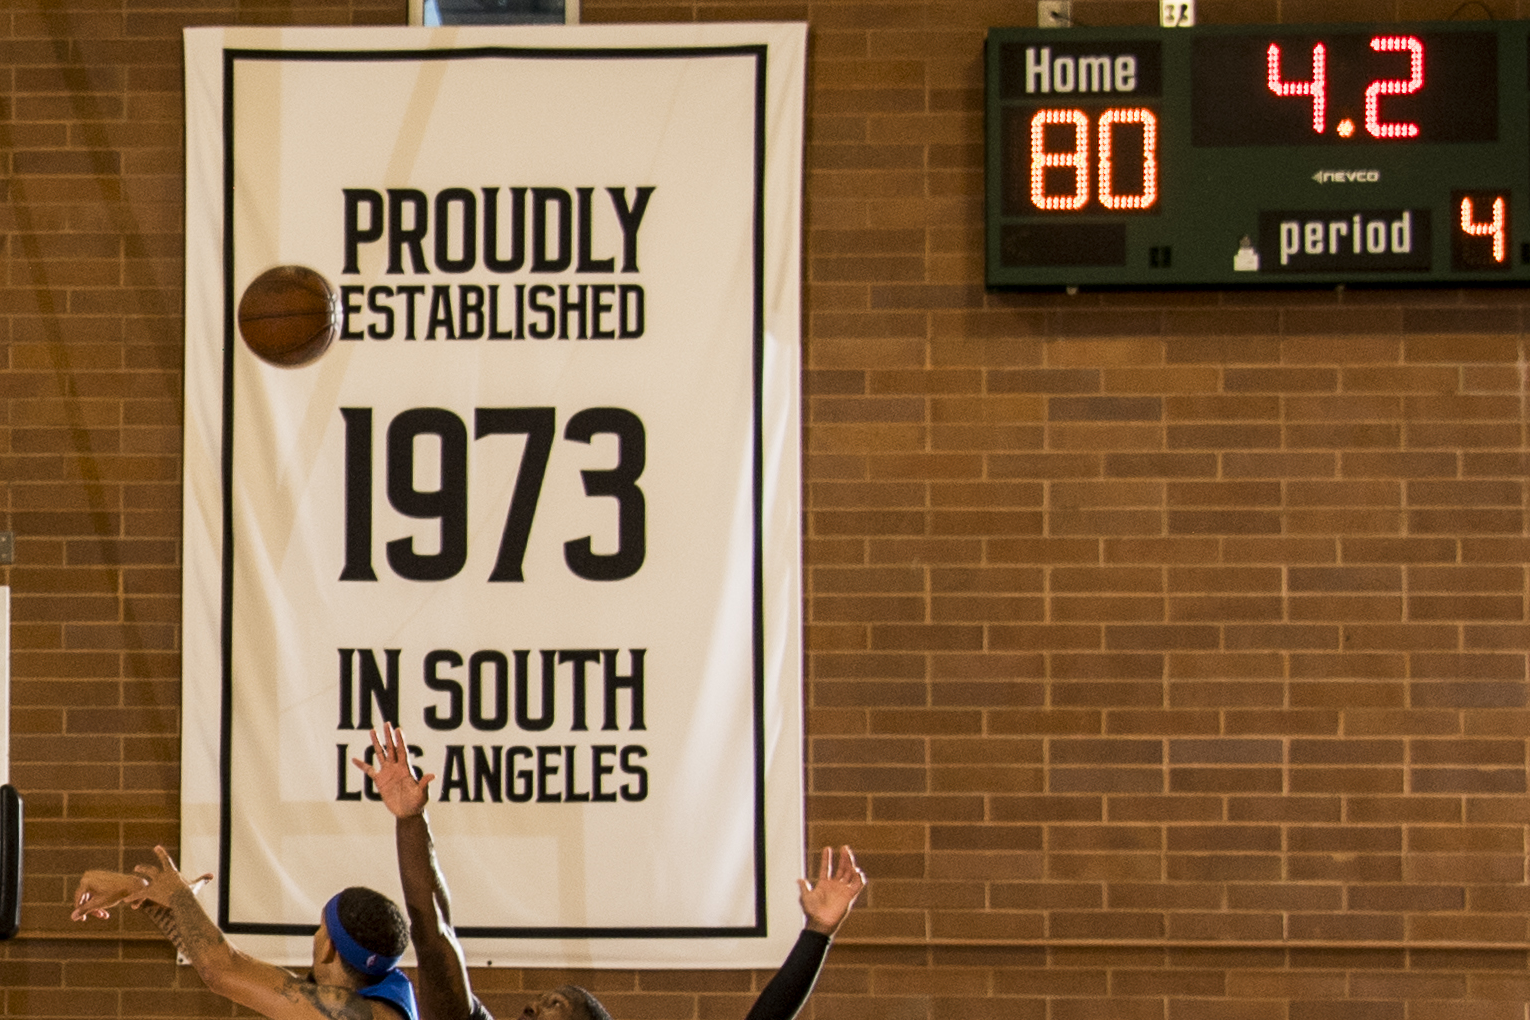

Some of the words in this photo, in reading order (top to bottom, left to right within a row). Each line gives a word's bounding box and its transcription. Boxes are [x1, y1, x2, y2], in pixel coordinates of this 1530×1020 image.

[1025, 48, 1137, 93] Home
[1268, 37, 1424, 138] 4.2
[1031, 109, 1157, 210] 80
[341, 187, 657, 275] PROUDLY
[1280, 211, 1412, 266] period
[1461, 196, 1506, 263] 4
[339, 284, 646, 341] ESTABLISHED
[338, 407, 647, 582] 1973
[336, 648, 402, 731] IN
[423, 648, 647, 732] SOUTH
[438, 744, 649, 803] ANGELES
